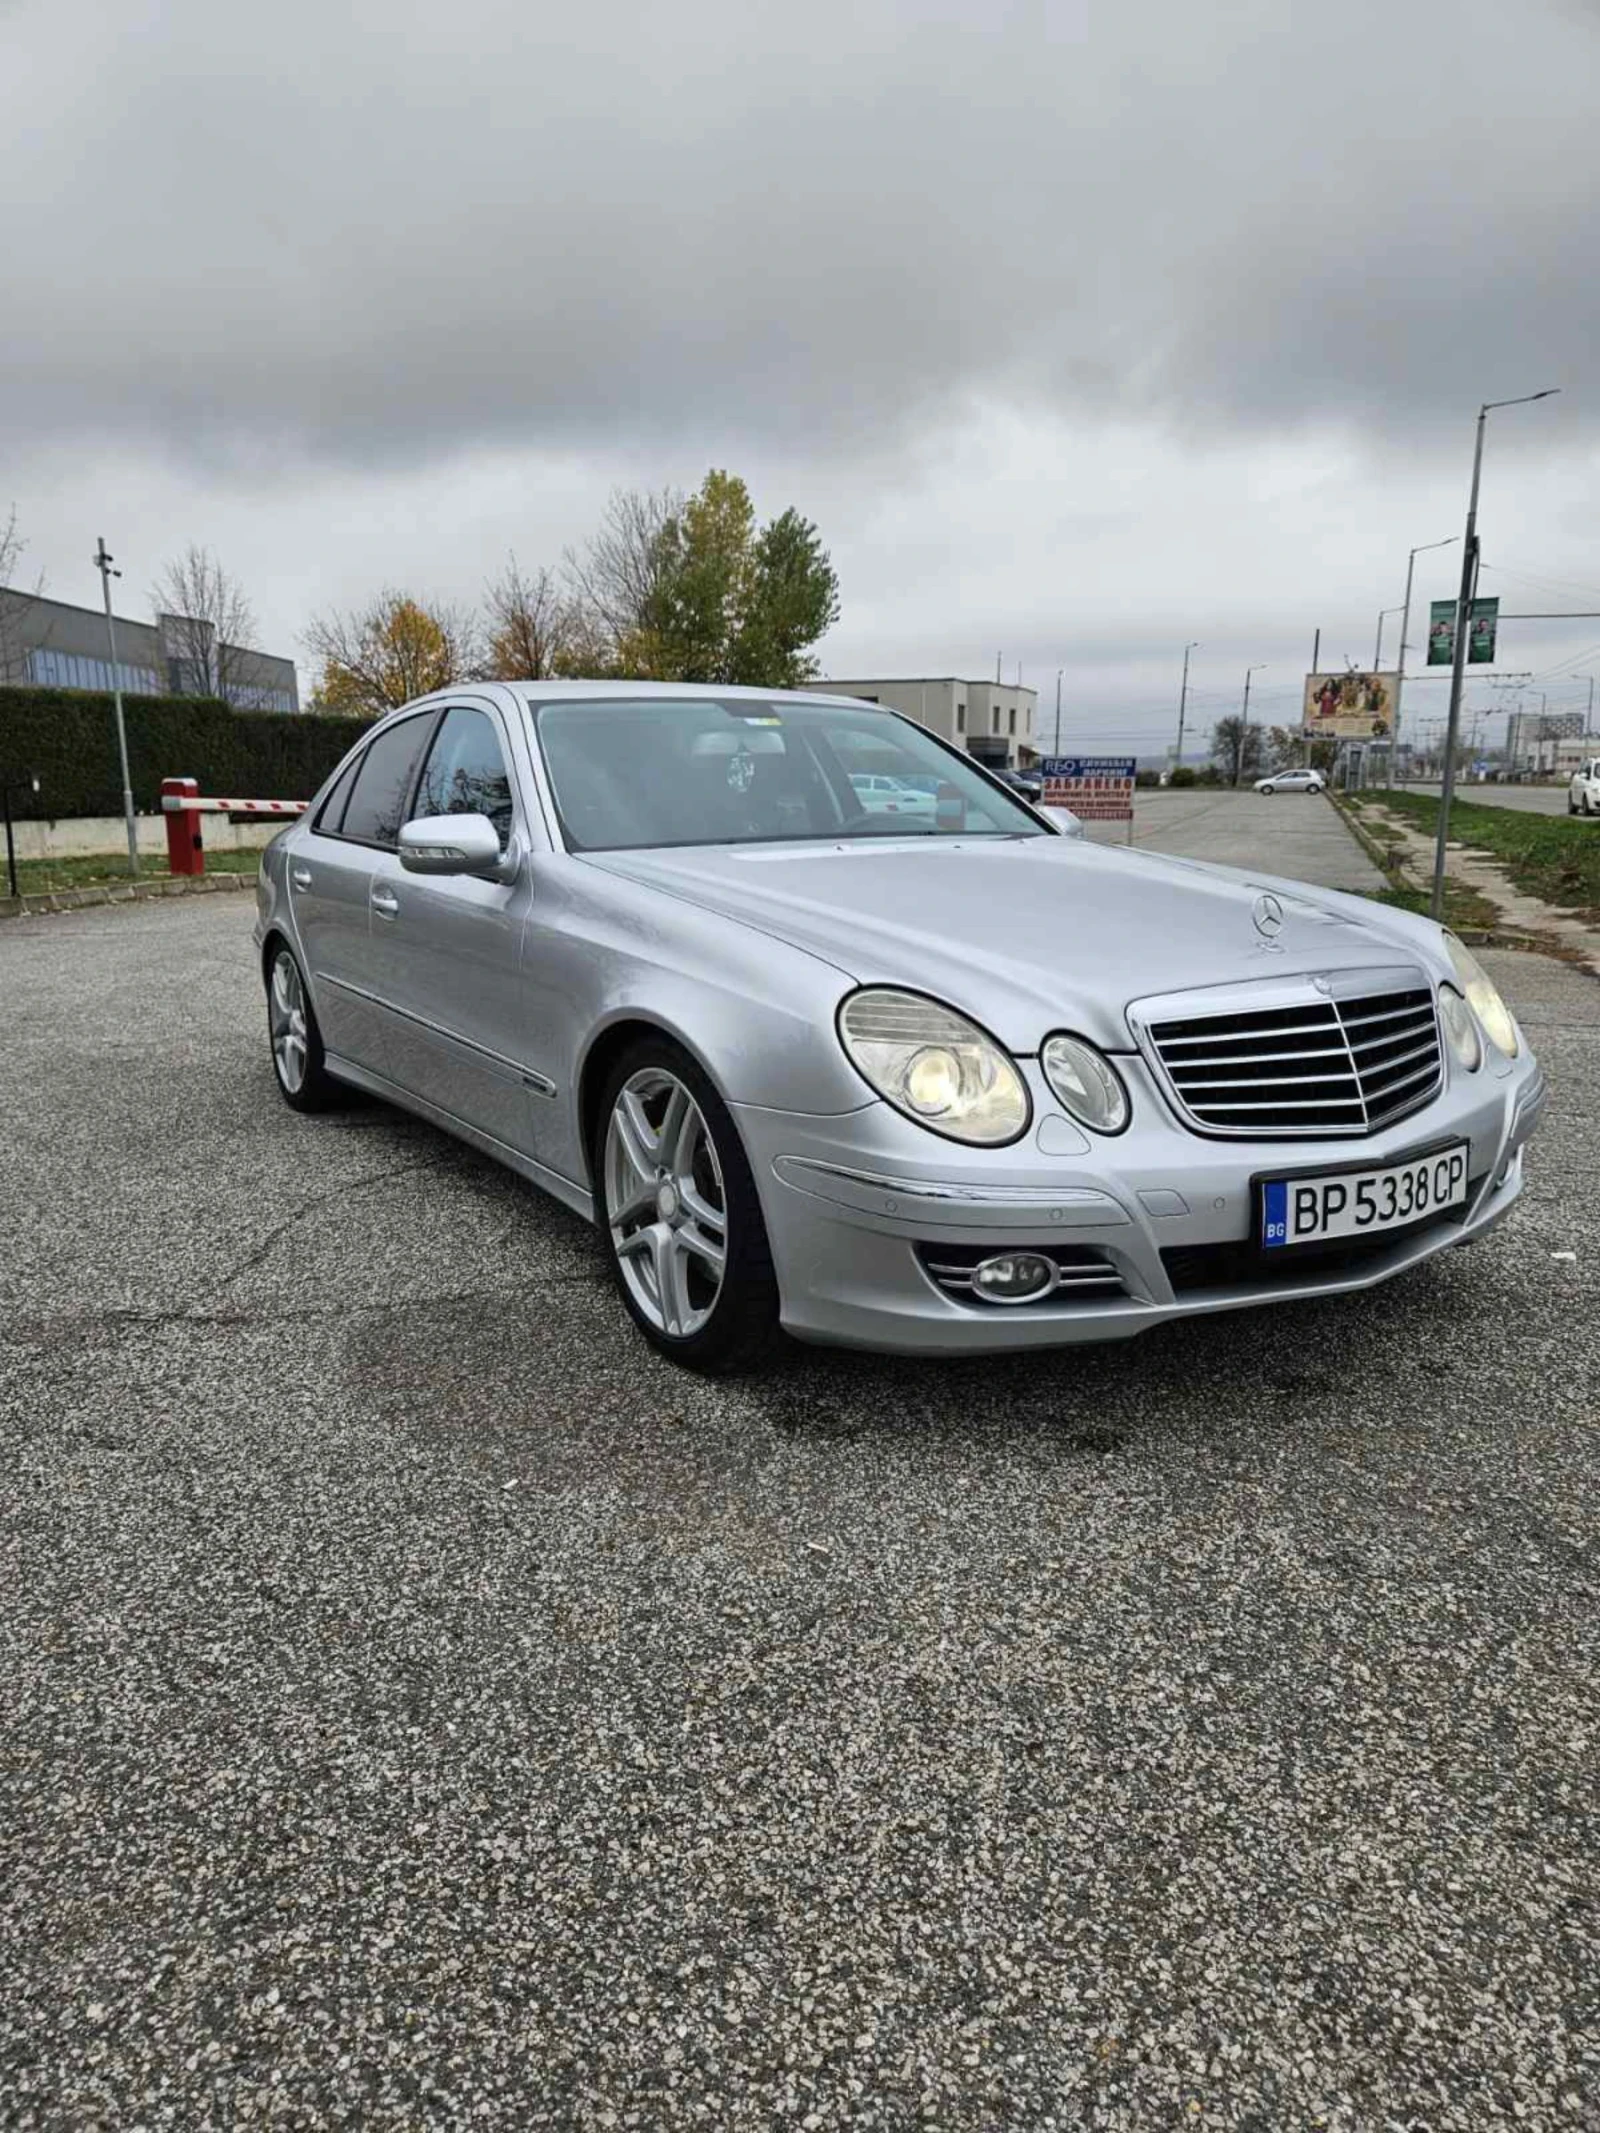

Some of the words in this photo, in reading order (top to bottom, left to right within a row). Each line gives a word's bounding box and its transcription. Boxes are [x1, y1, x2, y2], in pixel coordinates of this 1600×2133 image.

[1044, 778, 1132, 790] ЗАБРАНЕНО
[1294, 1183, 1347, 1236] BP
[1355, 1166, 1429, 1226] 5338
[1434, 1154, 1464, 1205] CP
[1267, 1222, 1285, 1238] BG
